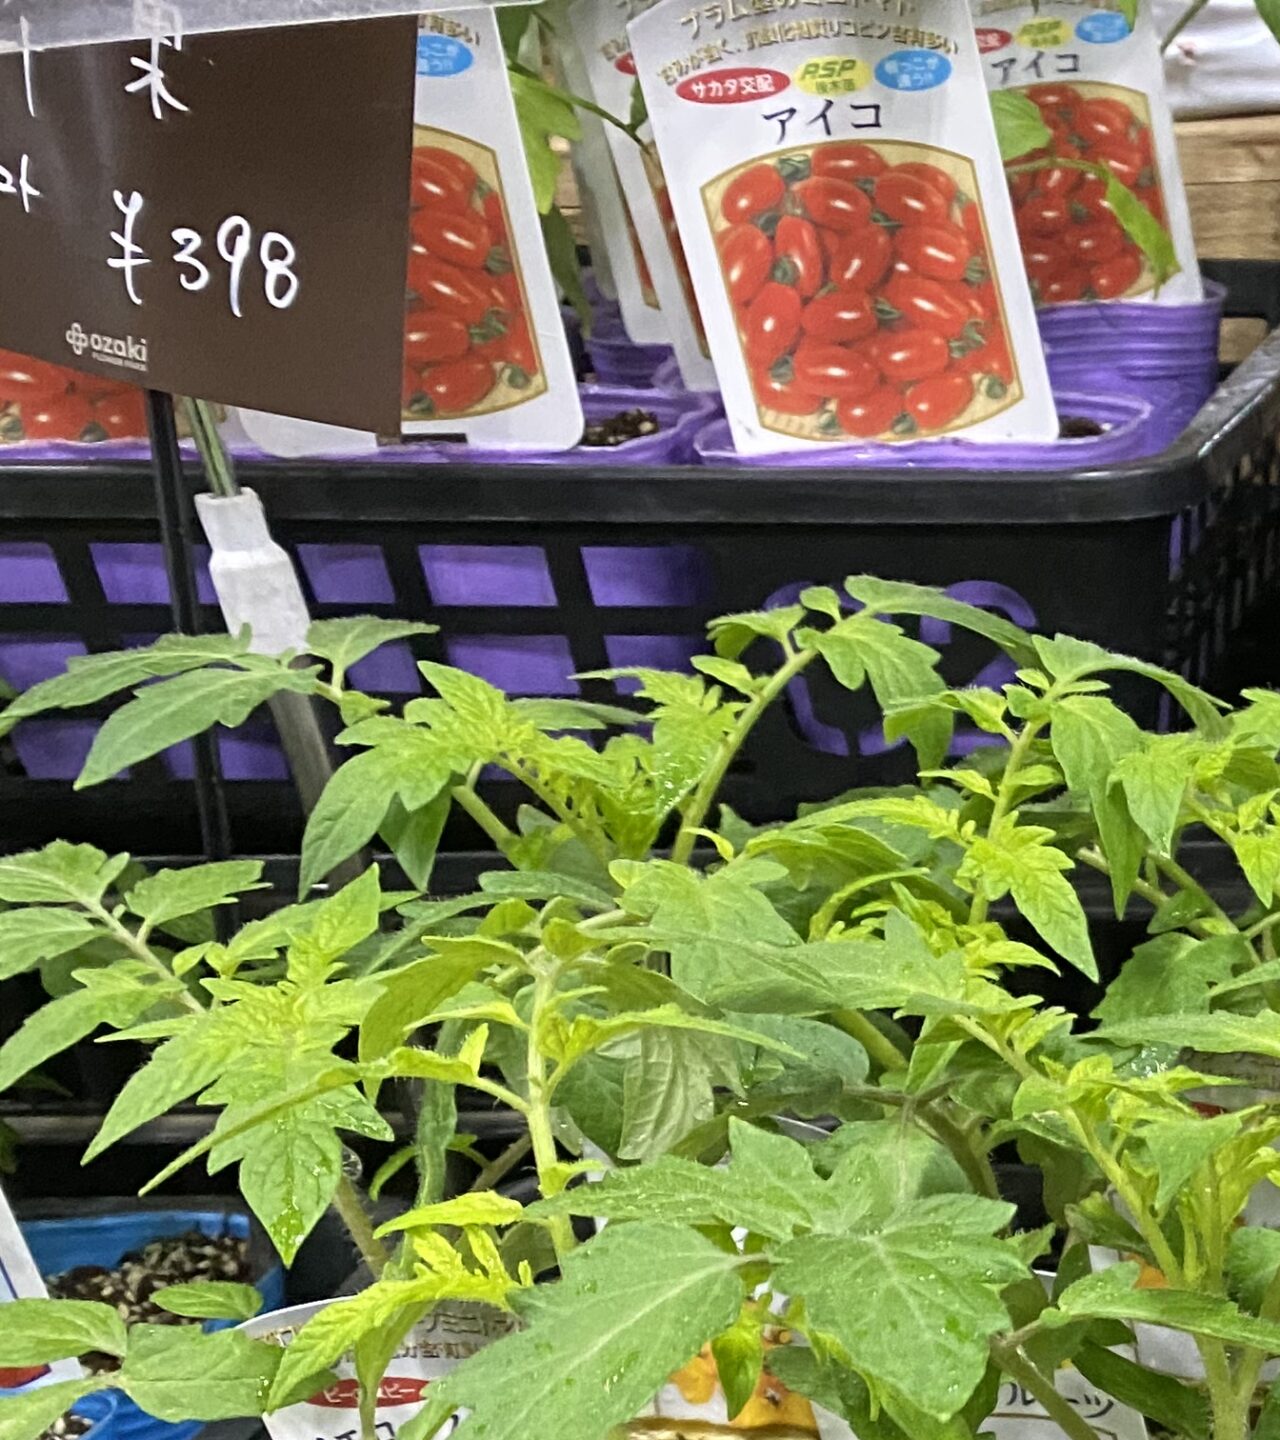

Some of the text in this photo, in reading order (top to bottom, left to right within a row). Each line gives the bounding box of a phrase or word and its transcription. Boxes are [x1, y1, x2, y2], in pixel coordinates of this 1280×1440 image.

[991, 51, 1081, 84] アイコ
[691, 73, 776, 99] サカタ交配
[762, 99, 882, 145] アイコ
[90, 335, 148, 361] ozaki
